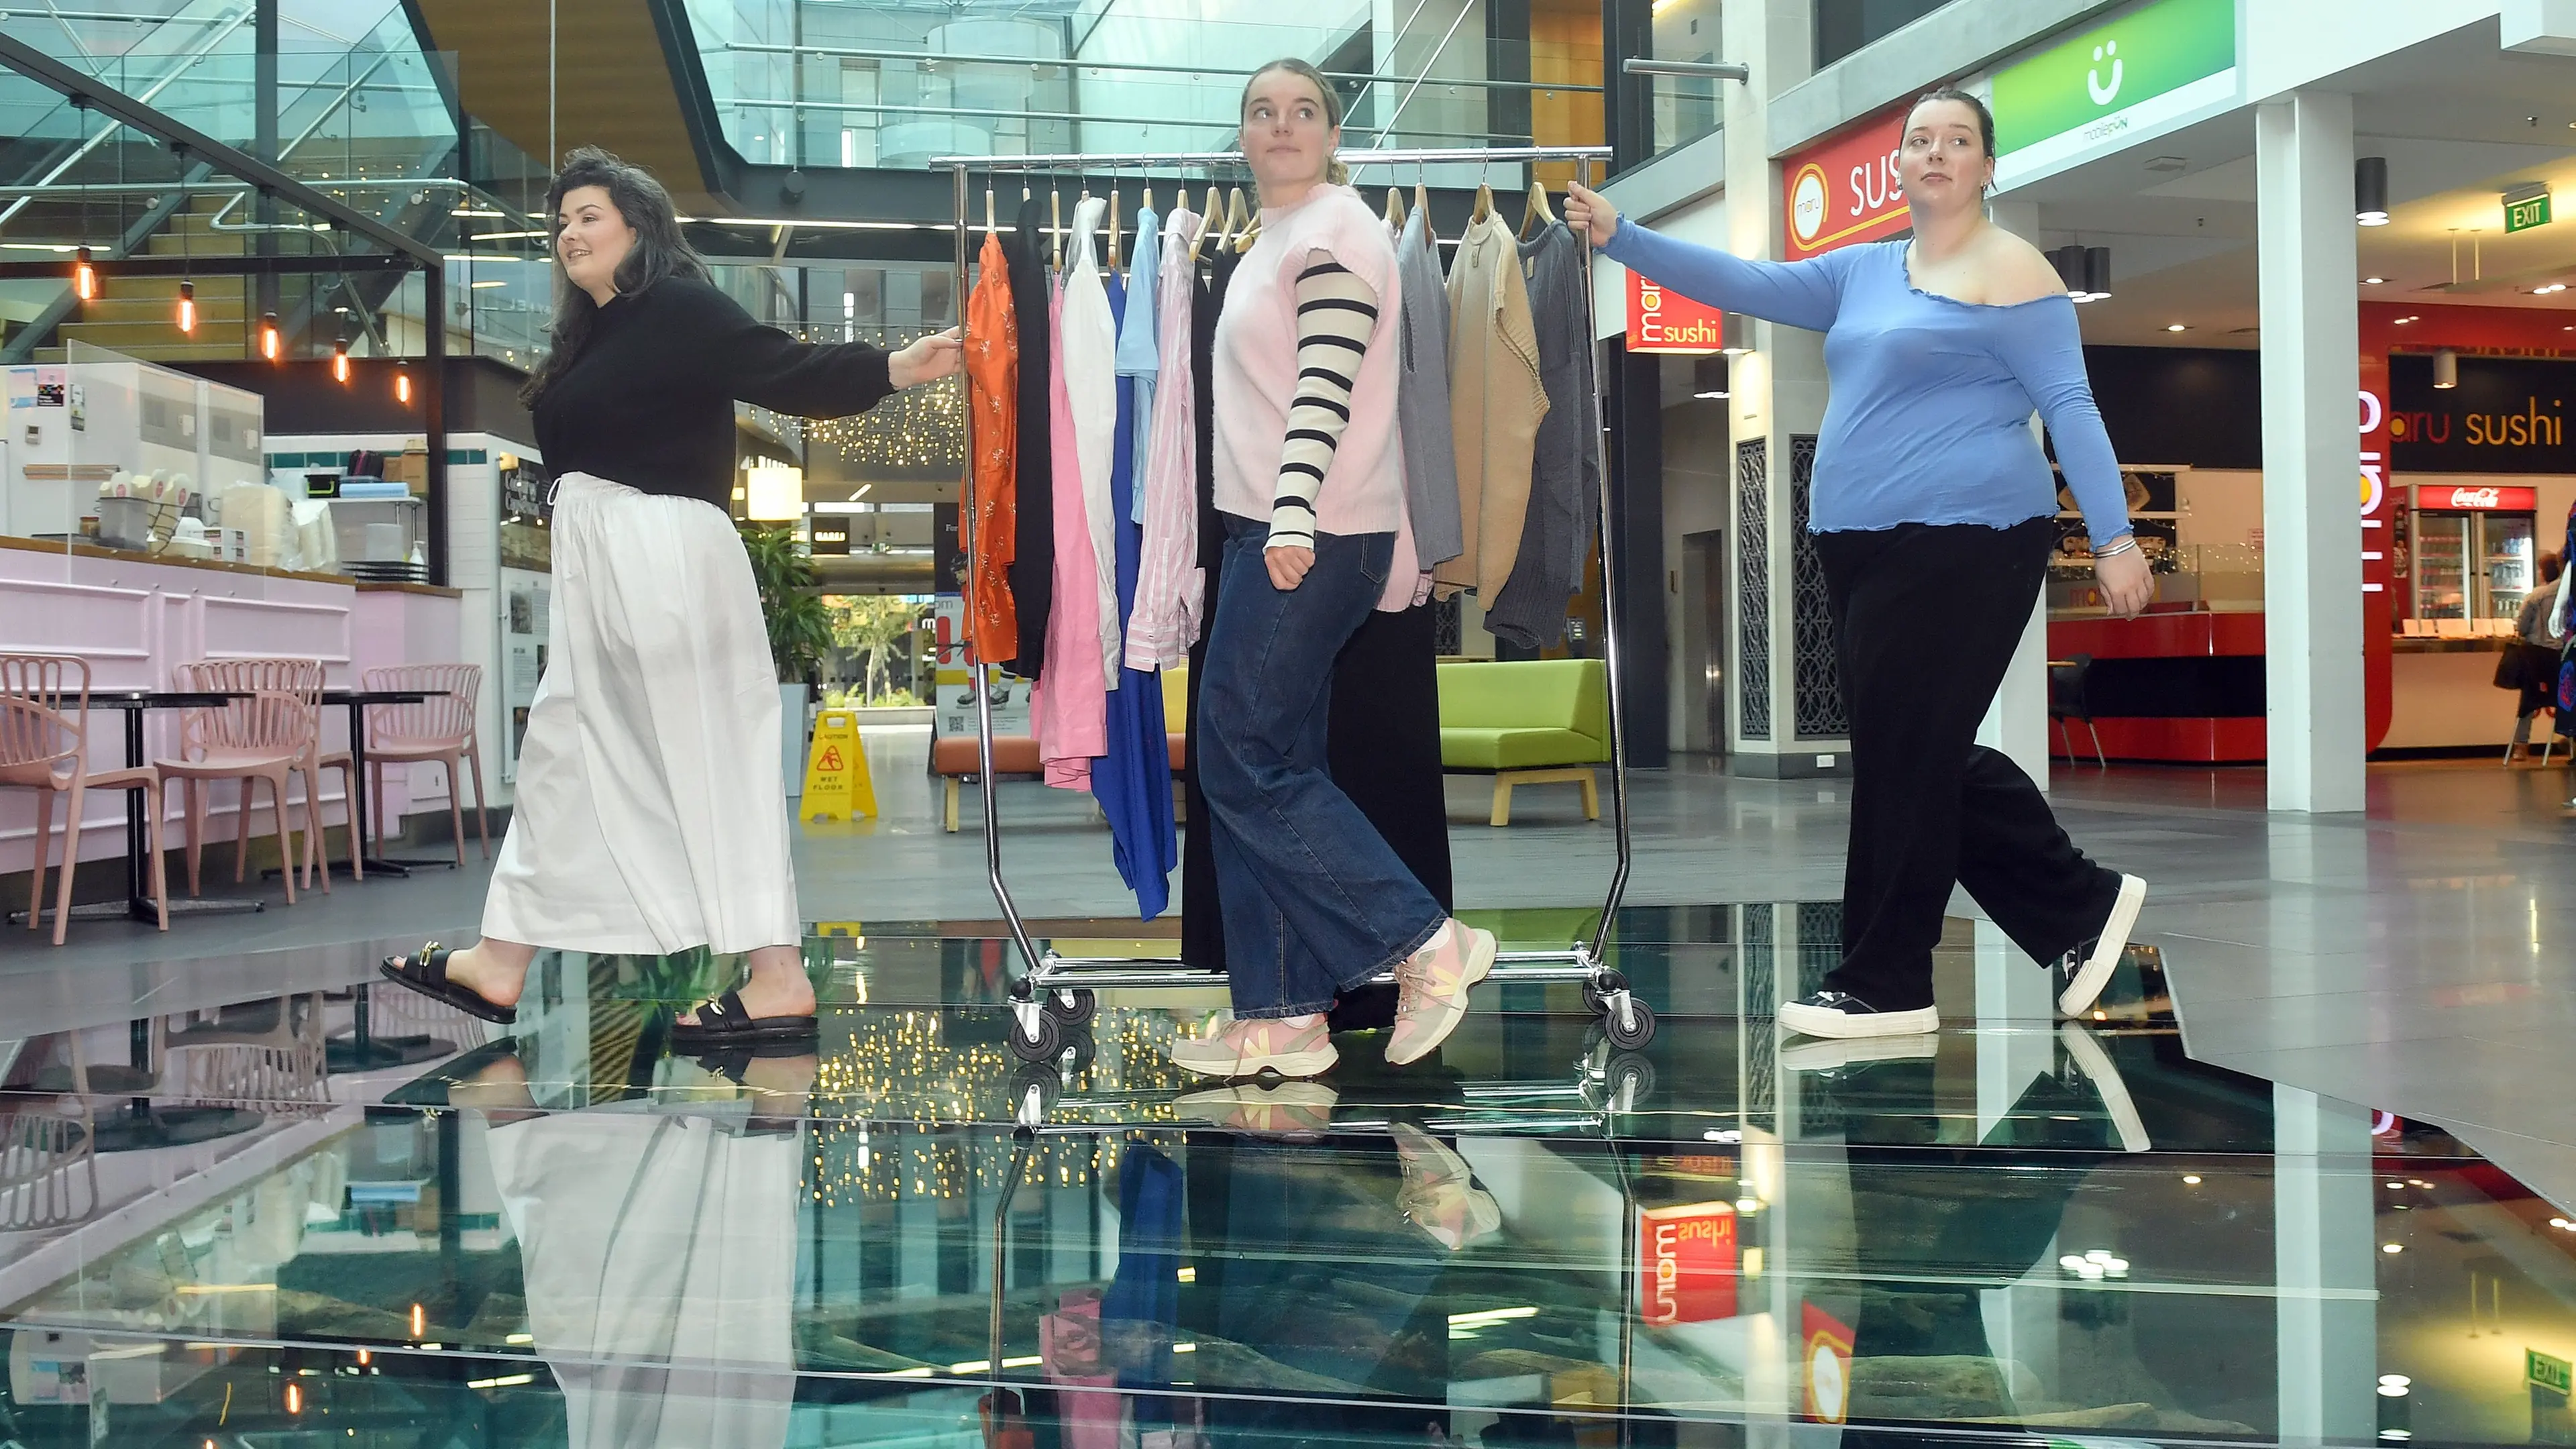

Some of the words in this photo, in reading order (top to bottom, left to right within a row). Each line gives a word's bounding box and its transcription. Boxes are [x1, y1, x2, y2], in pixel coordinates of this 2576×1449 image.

[1850, 150, 1904, 216] SUS
[2513, 203, 2541, 227] EXIT
[1641, 276, 1662, 341] mar
[1664, 318, 1716, 343] sushi
[2390, 411, 2450, 444] aru
[2466, 396, 2562, 445] sushi
